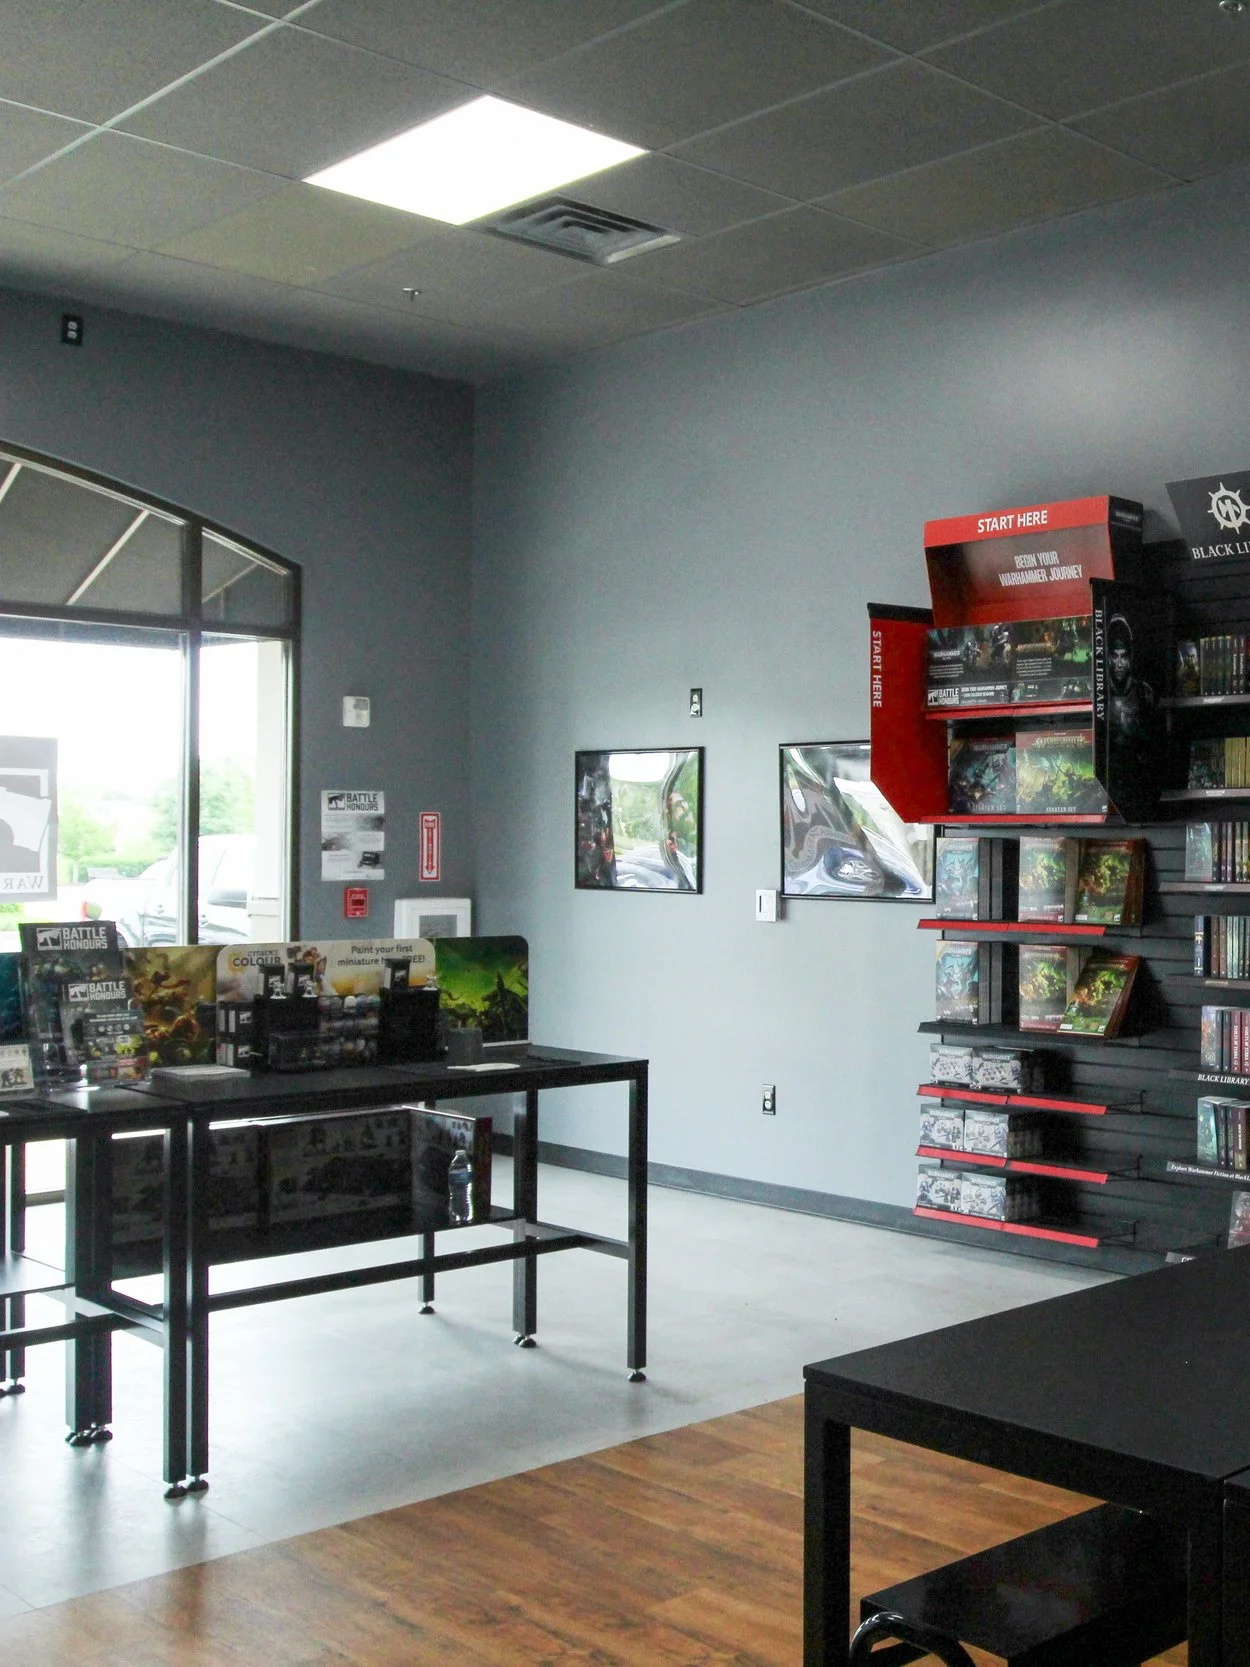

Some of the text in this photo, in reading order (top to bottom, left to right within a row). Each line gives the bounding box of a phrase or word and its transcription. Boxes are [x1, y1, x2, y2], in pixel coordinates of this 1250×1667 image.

[977, 510, 1048, 533] START HERE
[1192, 544, 1235, 559] BLACK
[1014, 551, 1059, 569] BEGIN YOUR
[999, 564, 1082, 587] WARHAMMER JOURNEY
[873, 631, 882, 707] START HERE
[1095, 610, 1104, 720] BLACK LIBRARY
[938, 688, 959, 697] BATTLE
[346, 793, 378, 803] BATTLE
[346, 803, 379, 811] HONOURS
[63, 927, 107, 939] BATTLE
[63, 939, 108, 950] HONOURS
[351, 945, 413, 955] Paint your first
[232, 956, 281, 967] COLOUR
[337, 957, 380, 966] miniature
[89, 981, 125, 993] BATTLE
[90, 991, 126, 1000] HONOURS
[1198, 1074, 1249, 1085] BLACK LIBRARY
[1171, 1164, 1188, 1174] Explore
[1188, 1165, 1213, 1176] Warhammer
[1213, 1169, 1230, 1178] Fiction
